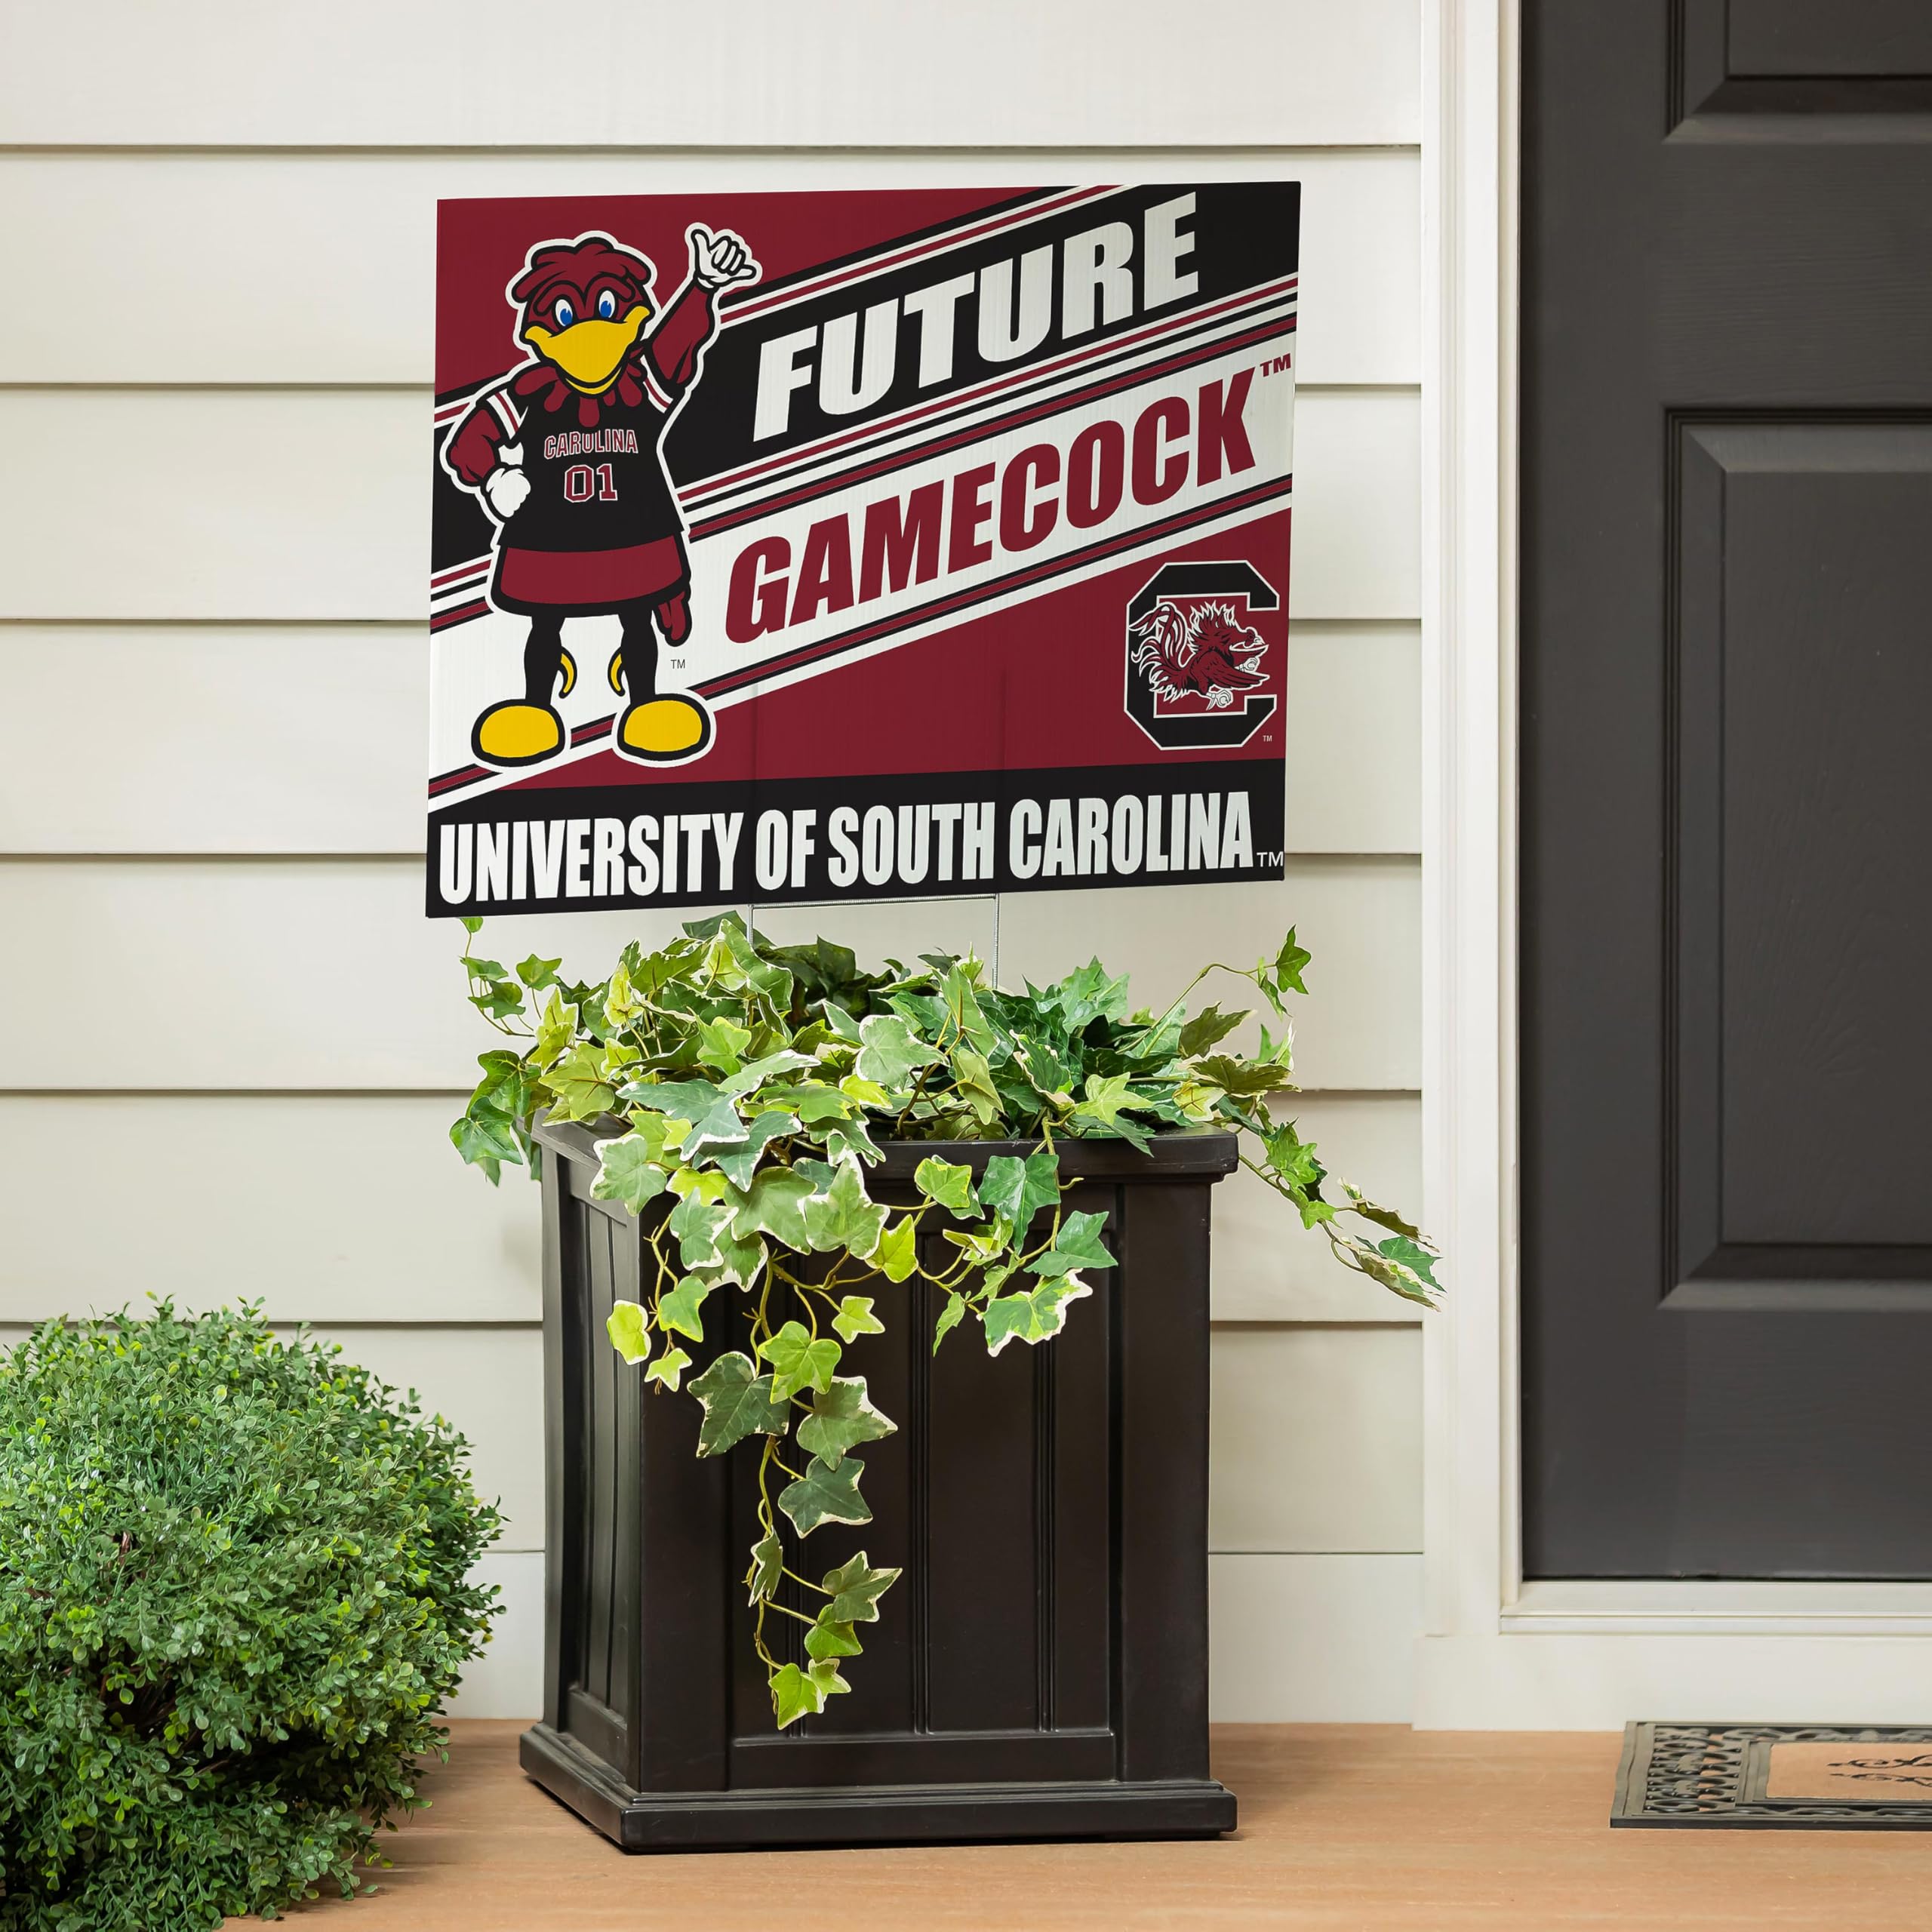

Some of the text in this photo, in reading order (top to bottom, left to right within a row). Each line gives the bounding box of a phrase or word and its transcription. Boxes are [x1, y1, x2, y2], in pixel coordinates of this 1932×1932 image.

[753, 192, 1199, 442] FUTURE
[563, 463, 618, 503] 01
[726, 367, 1256, 644] GAMECOCK
[670, 660, 685, 669] TM
[439, 812, 744, 905] UNIVERSITY
[755, 809, 817, 891] OF
[828, 801, 995, 887] SOUTH
[1009, 791, 1254, 879] CAROLINA
